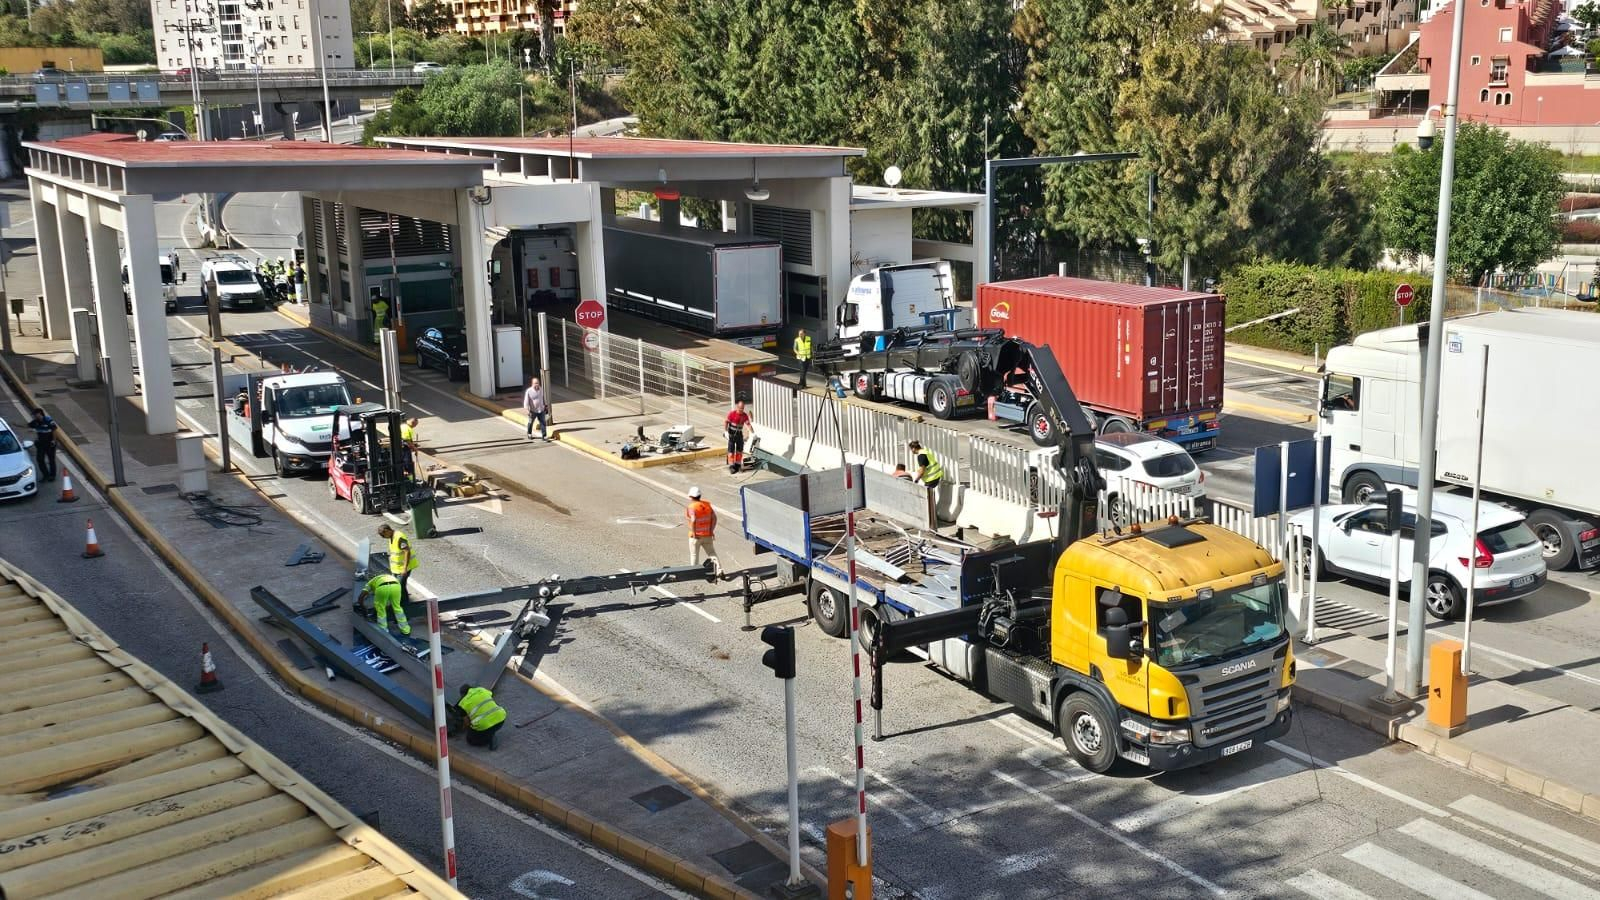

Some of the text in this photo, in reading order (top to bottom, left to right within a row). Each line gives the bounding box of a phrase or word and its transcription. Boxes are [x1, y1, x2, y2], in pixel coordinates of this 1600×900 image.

[1398, 291, 1413, 299] STOP
[578, 311, 603, 320] STOP
[1221, 660, 1257, 676] SCANIA
